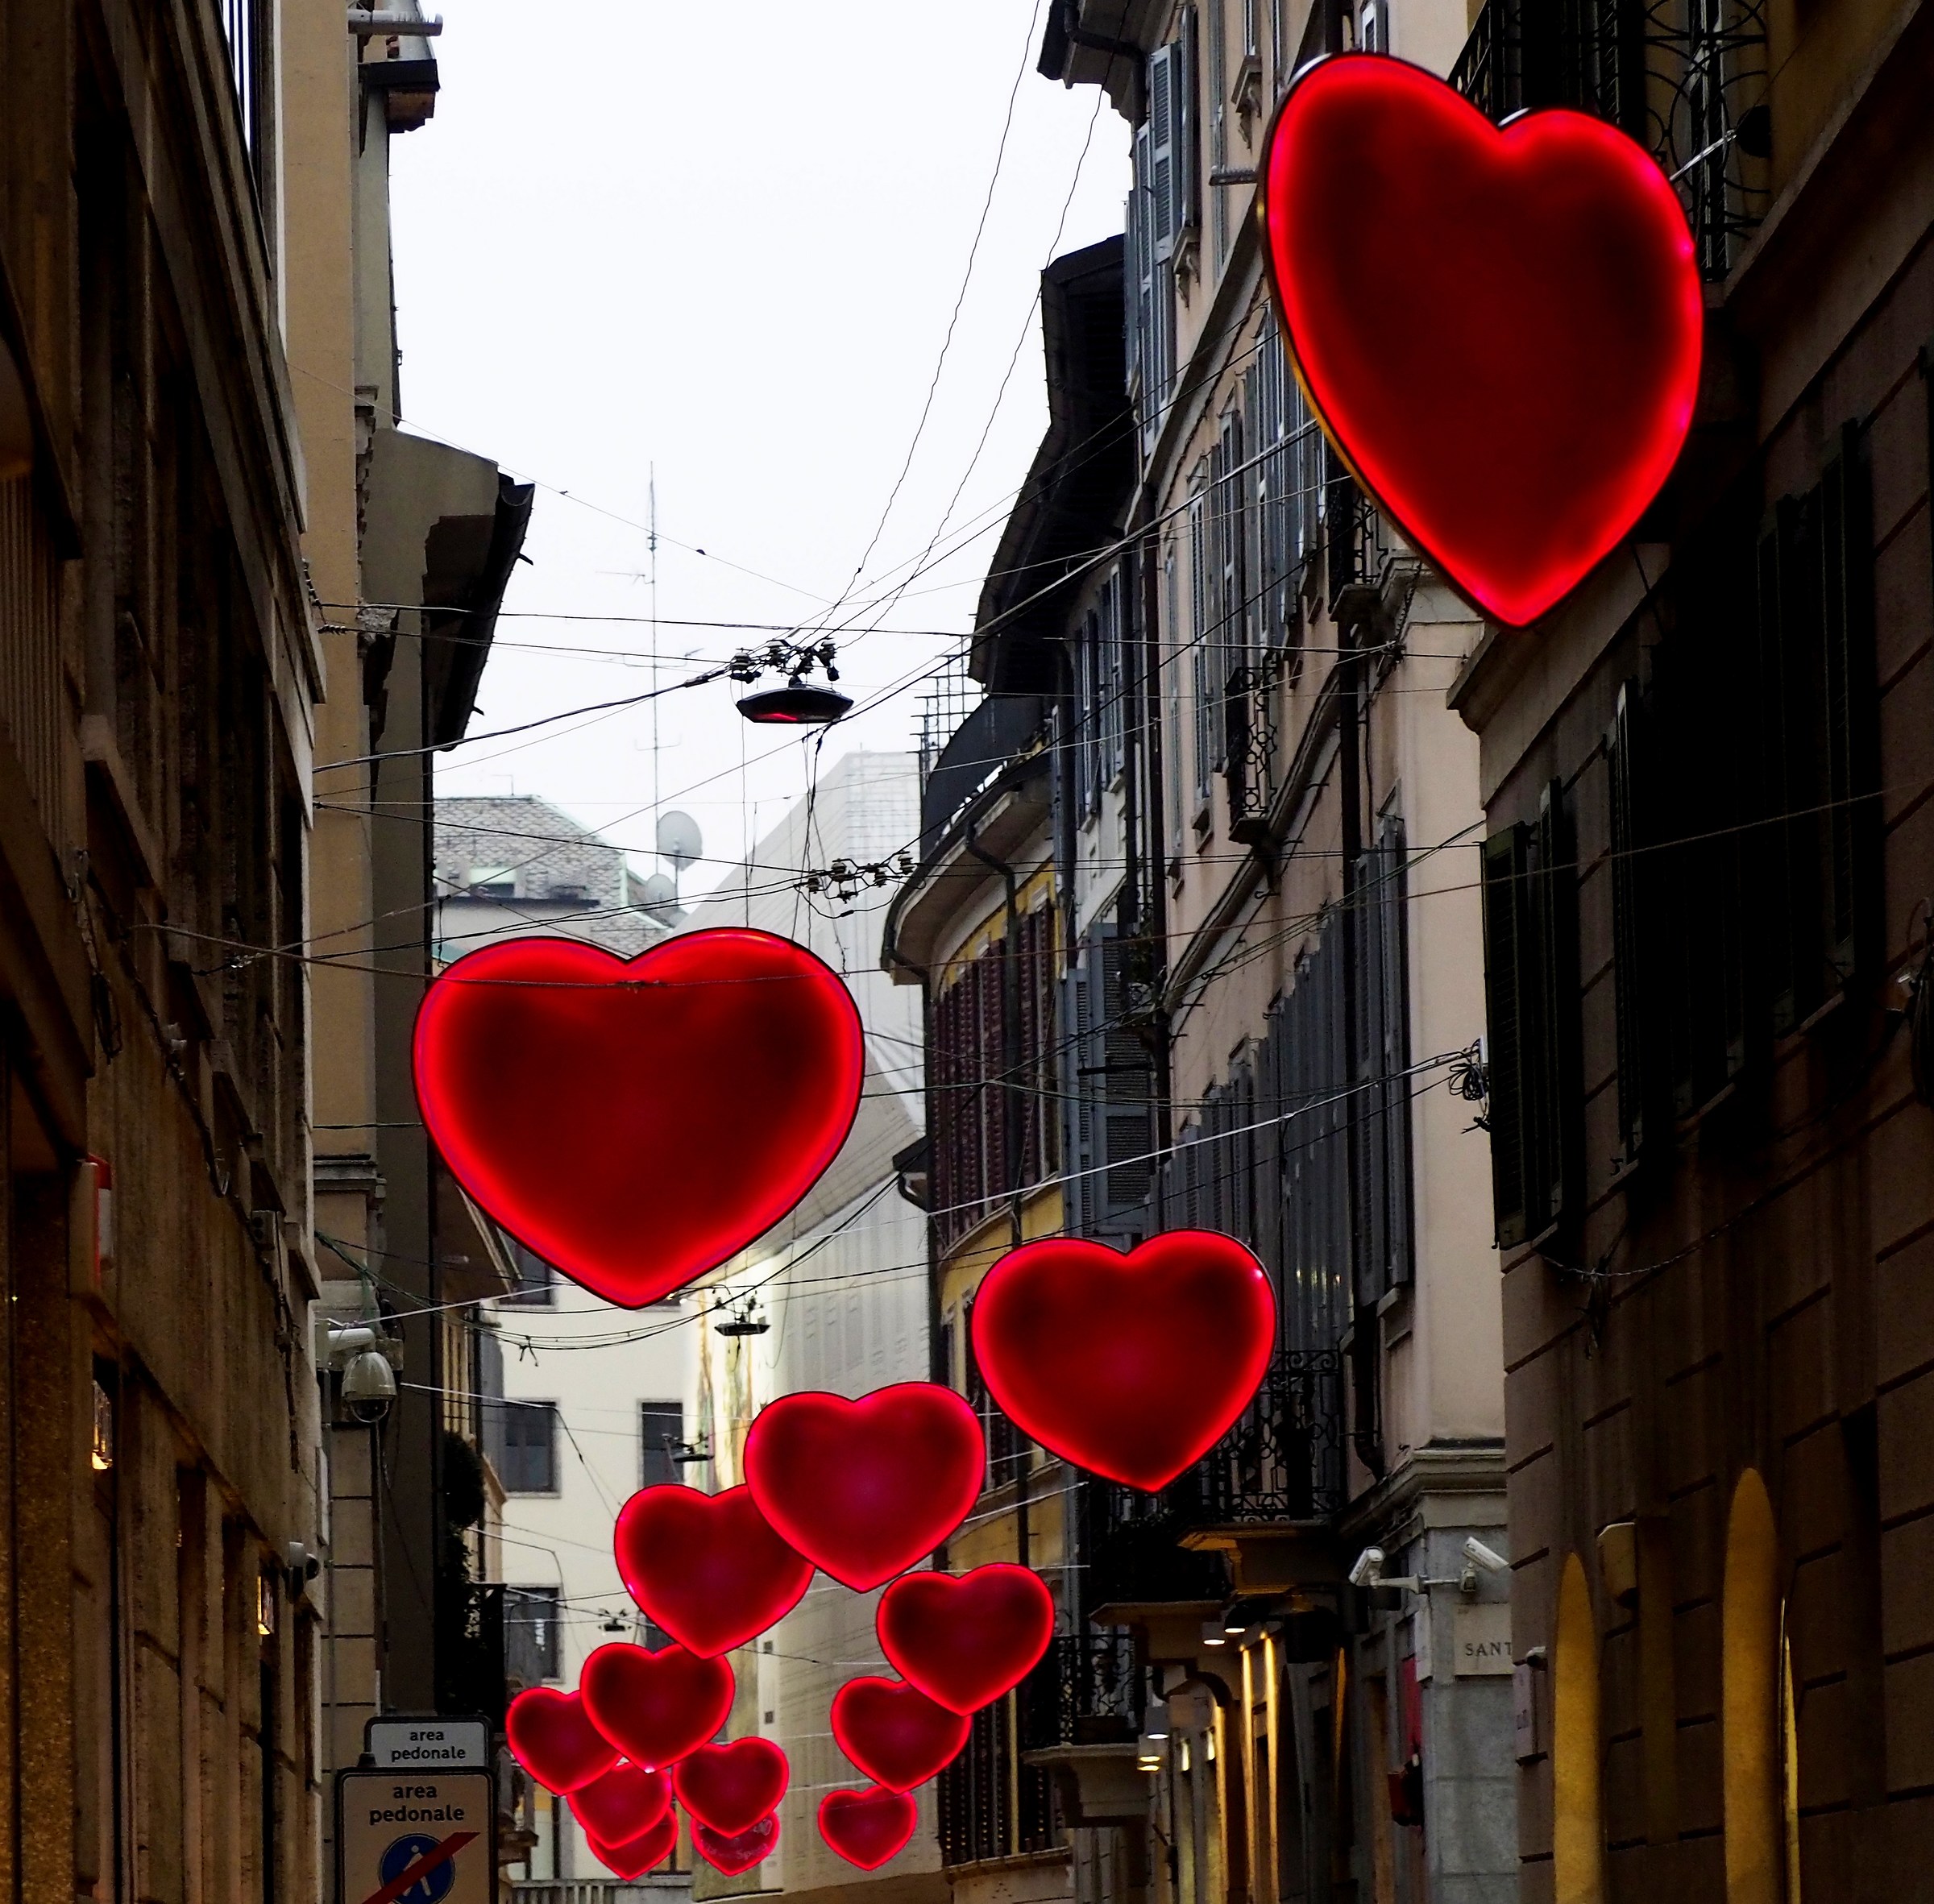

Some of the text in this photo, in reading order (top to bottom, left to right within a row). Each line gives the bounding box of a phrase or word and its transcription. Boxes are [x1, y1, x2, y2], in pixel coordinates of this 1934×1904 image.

[409, 1731, 445, 1741] area
[391, 1745, 466, 1762] pedonale
[392, 1786, 438, 1798] area
[369, 1805, 465, 1825] pedonale
